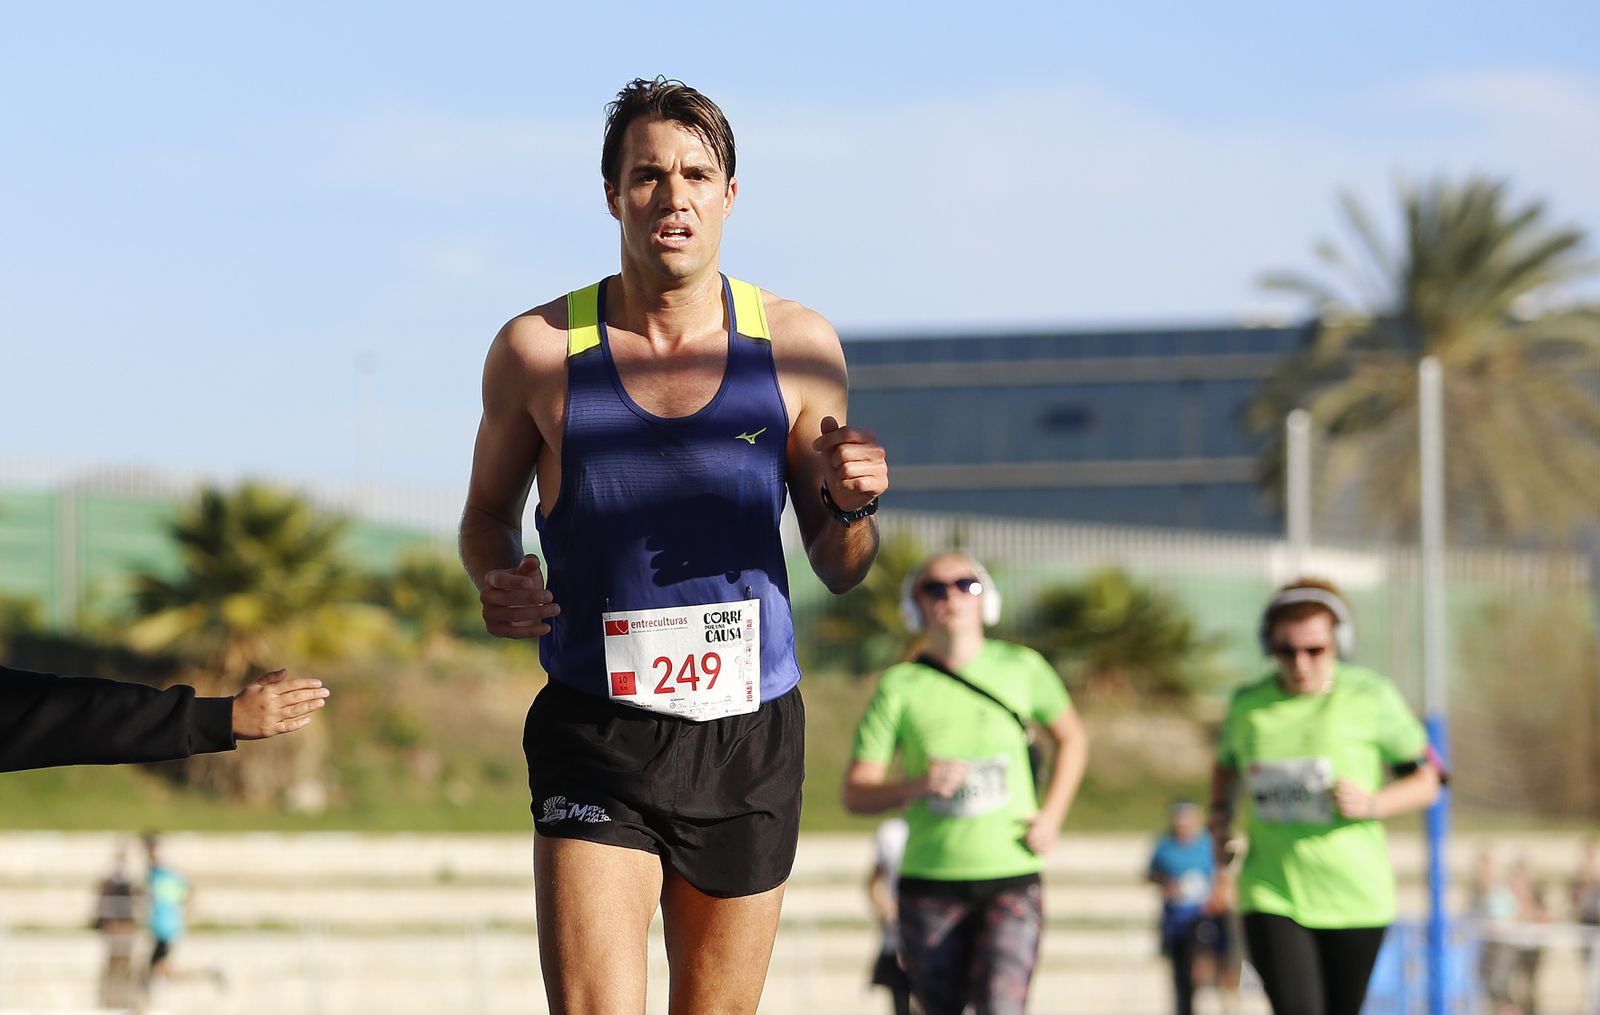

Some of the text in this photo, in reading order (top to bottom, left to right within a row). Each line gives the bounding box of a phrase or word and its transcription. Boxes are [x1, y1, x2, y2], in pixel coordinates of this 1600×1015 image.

[631, 616, 688, 629] entreculturas
[703, 609, 742, 625] CORRE
[705, 627, 742, 643] CAUSA
[619, 675, 628, 684] 10
[652, 651, 722, 694] 249
